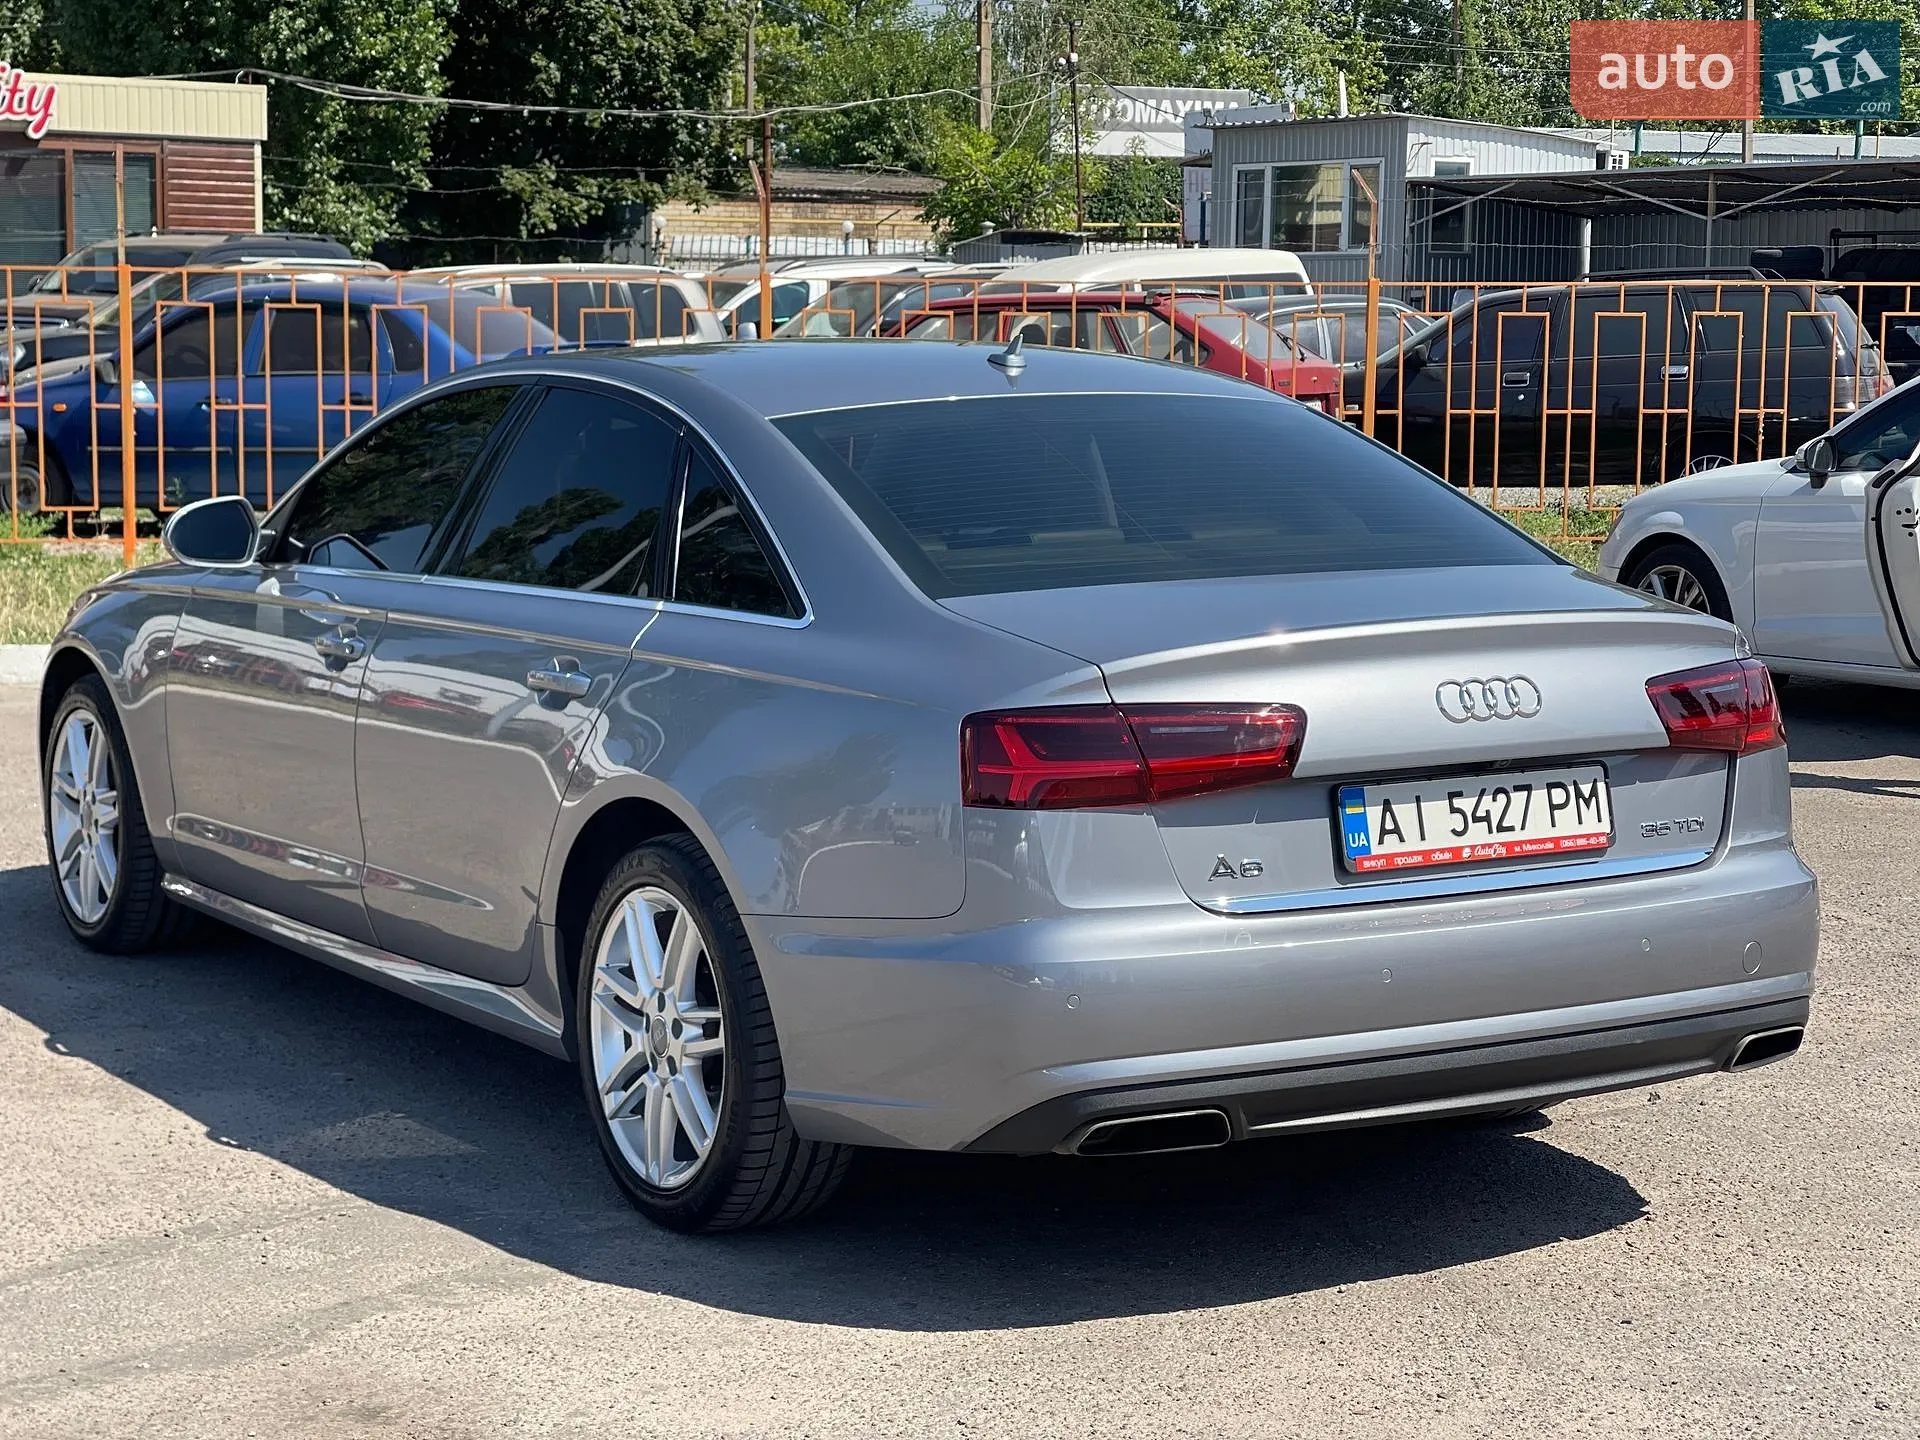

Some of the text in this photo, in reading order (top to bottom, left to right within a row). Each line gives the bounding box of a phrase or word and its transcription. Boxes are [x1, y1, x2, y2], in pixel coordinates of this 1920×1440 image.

[1378, 778, 1603, 846] AI 5427 PM
[1348, 831, 1369, 848] UA
[1207, 853, 1264, 881] A6
